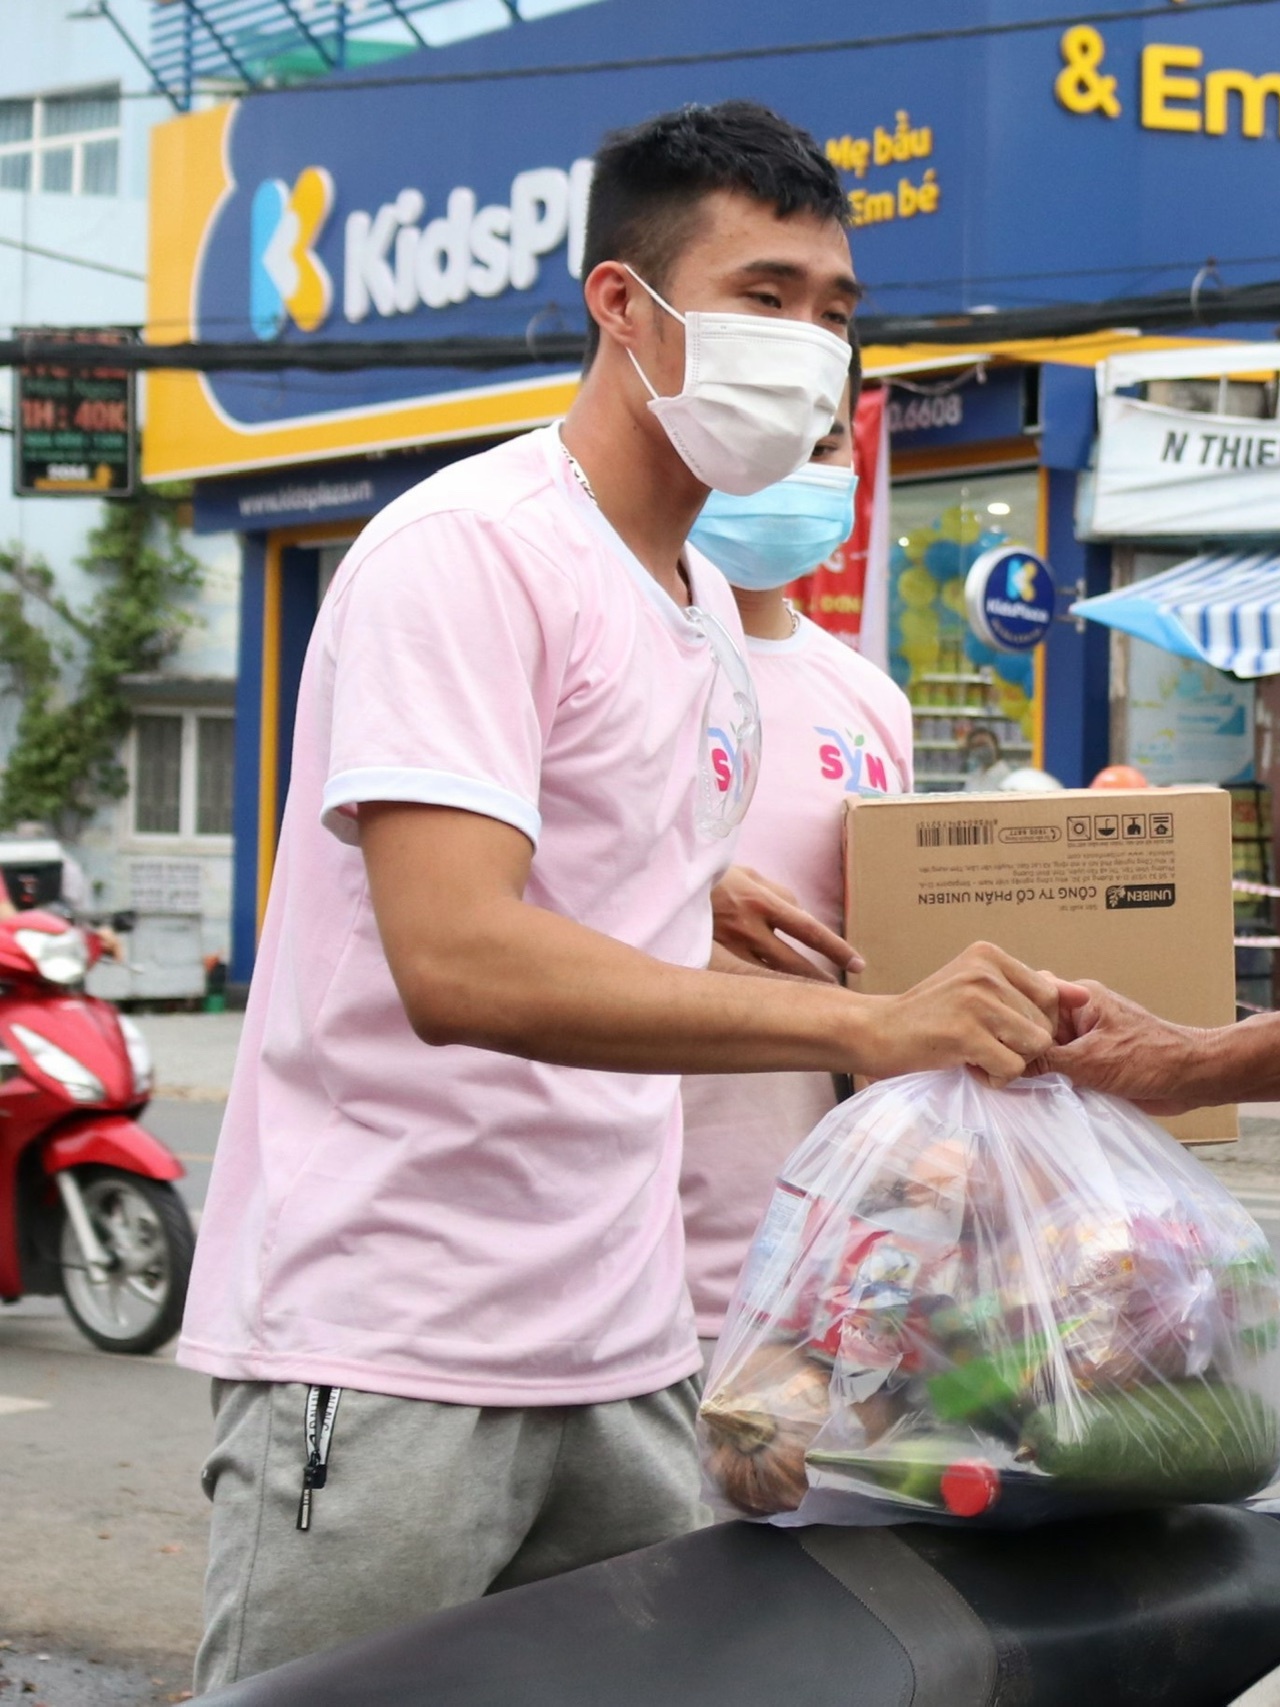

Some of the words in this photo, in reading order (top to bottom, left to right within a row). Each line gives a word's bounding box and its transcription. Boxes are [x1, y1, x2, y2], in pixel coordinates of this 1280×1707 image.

[1055, 24, 1122, 118] &
[873, 109, 933, 166] bầu
[847, 188, 895, 226] Em
[898, 167, 939, 217] bé
[918, 892, 970, 905] UNIBEN
[1016, 889, 1035, 906] CỔ
[1039, 888, 1055, 900] TY
[1058, 886, 1097, 901] CÔNG
[1127, 889, 1172, 902] UNIBEN
